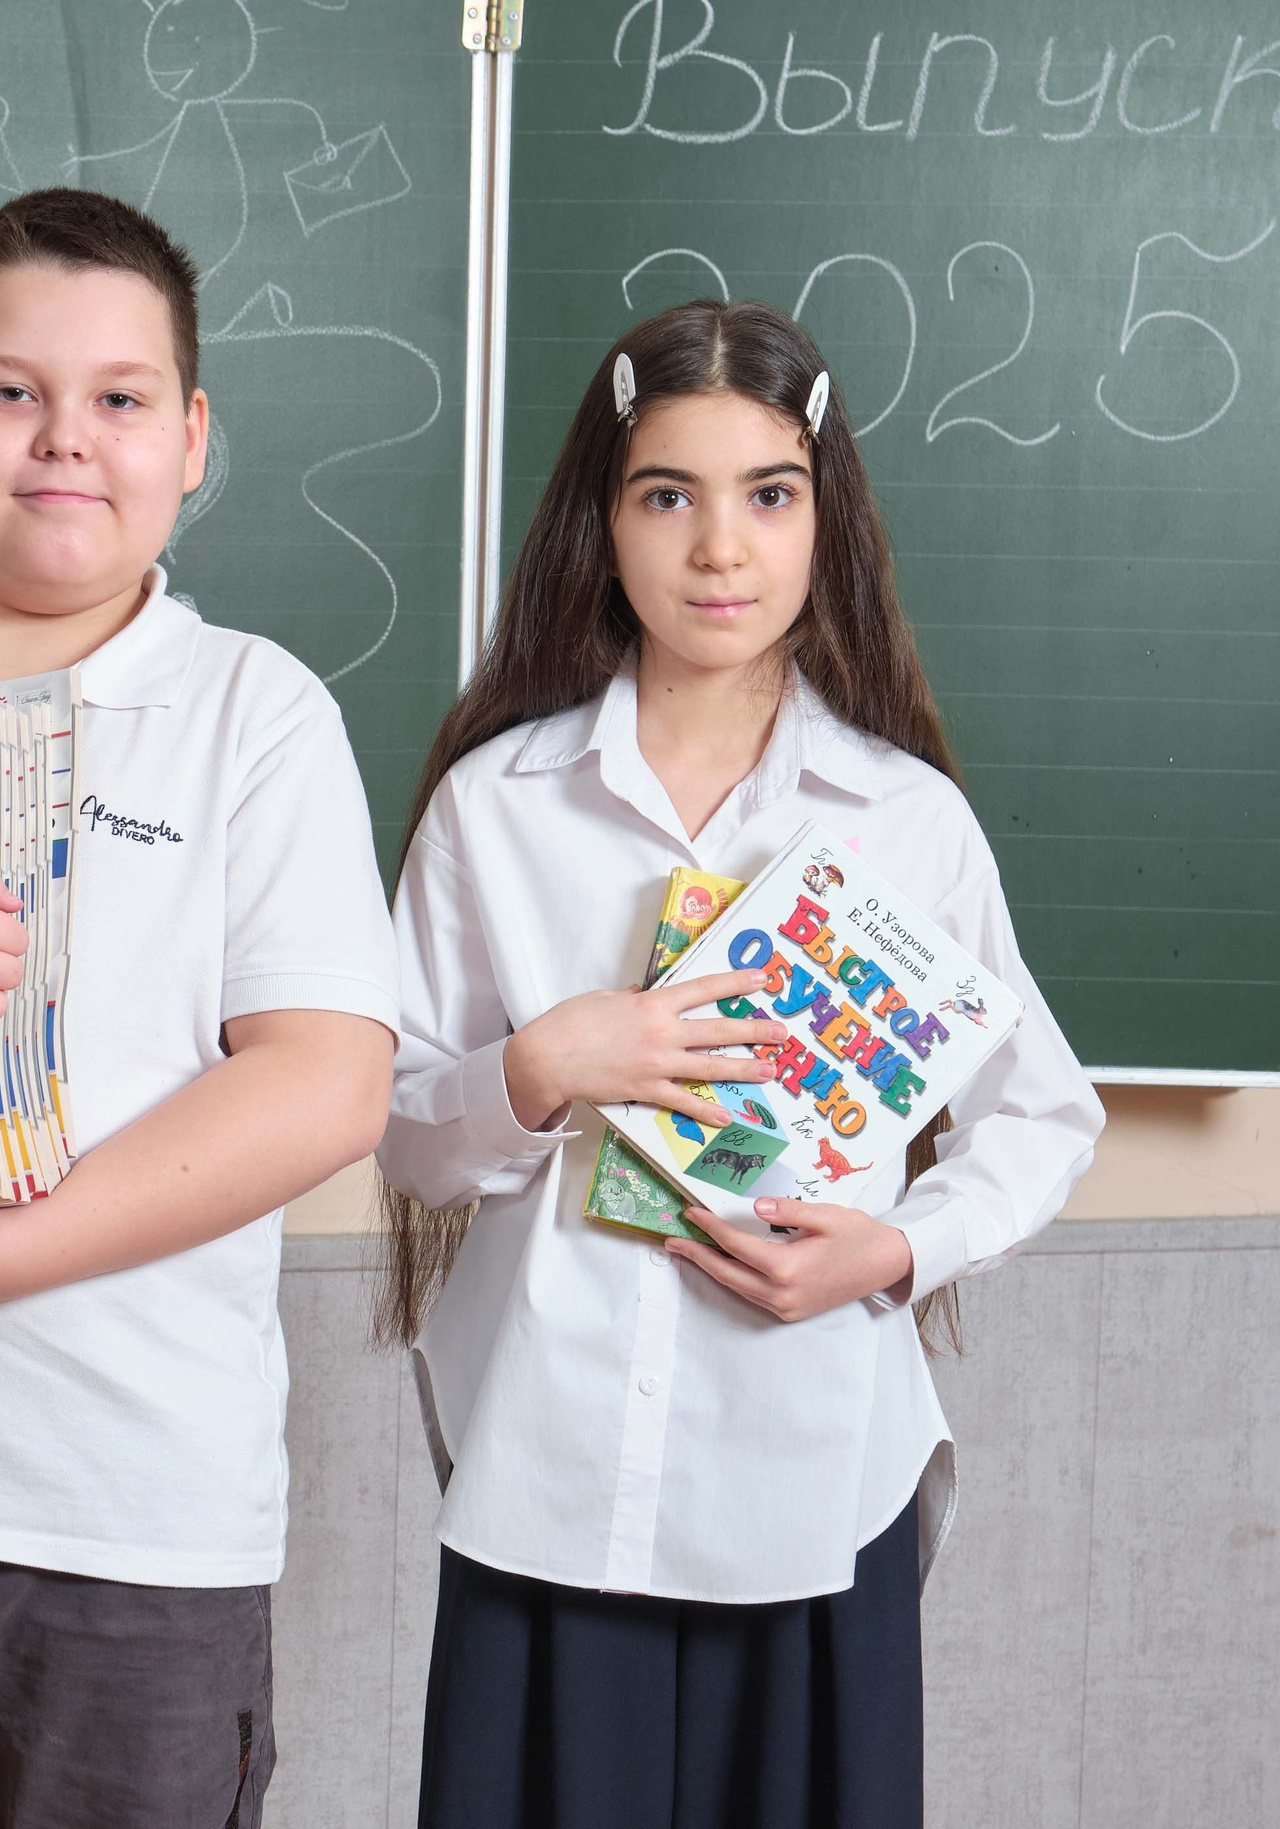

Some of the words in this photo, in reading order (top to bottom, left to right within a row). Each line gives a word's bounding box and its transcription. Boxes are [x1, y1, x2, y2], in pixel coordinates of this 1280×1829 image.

[111, 826, 155, 845] DIVERO
[847, 907, 860, 926] Е.
[863, 920, 928, 982] Нефёдова
[865, 898, 878, 916] О.
[882, 911, 936, 965] Узорова
[777, 893, 951, 1058] БЫСТРОЕ
[728, 928, 927, 1117] ОБУЧЕНИЕ
